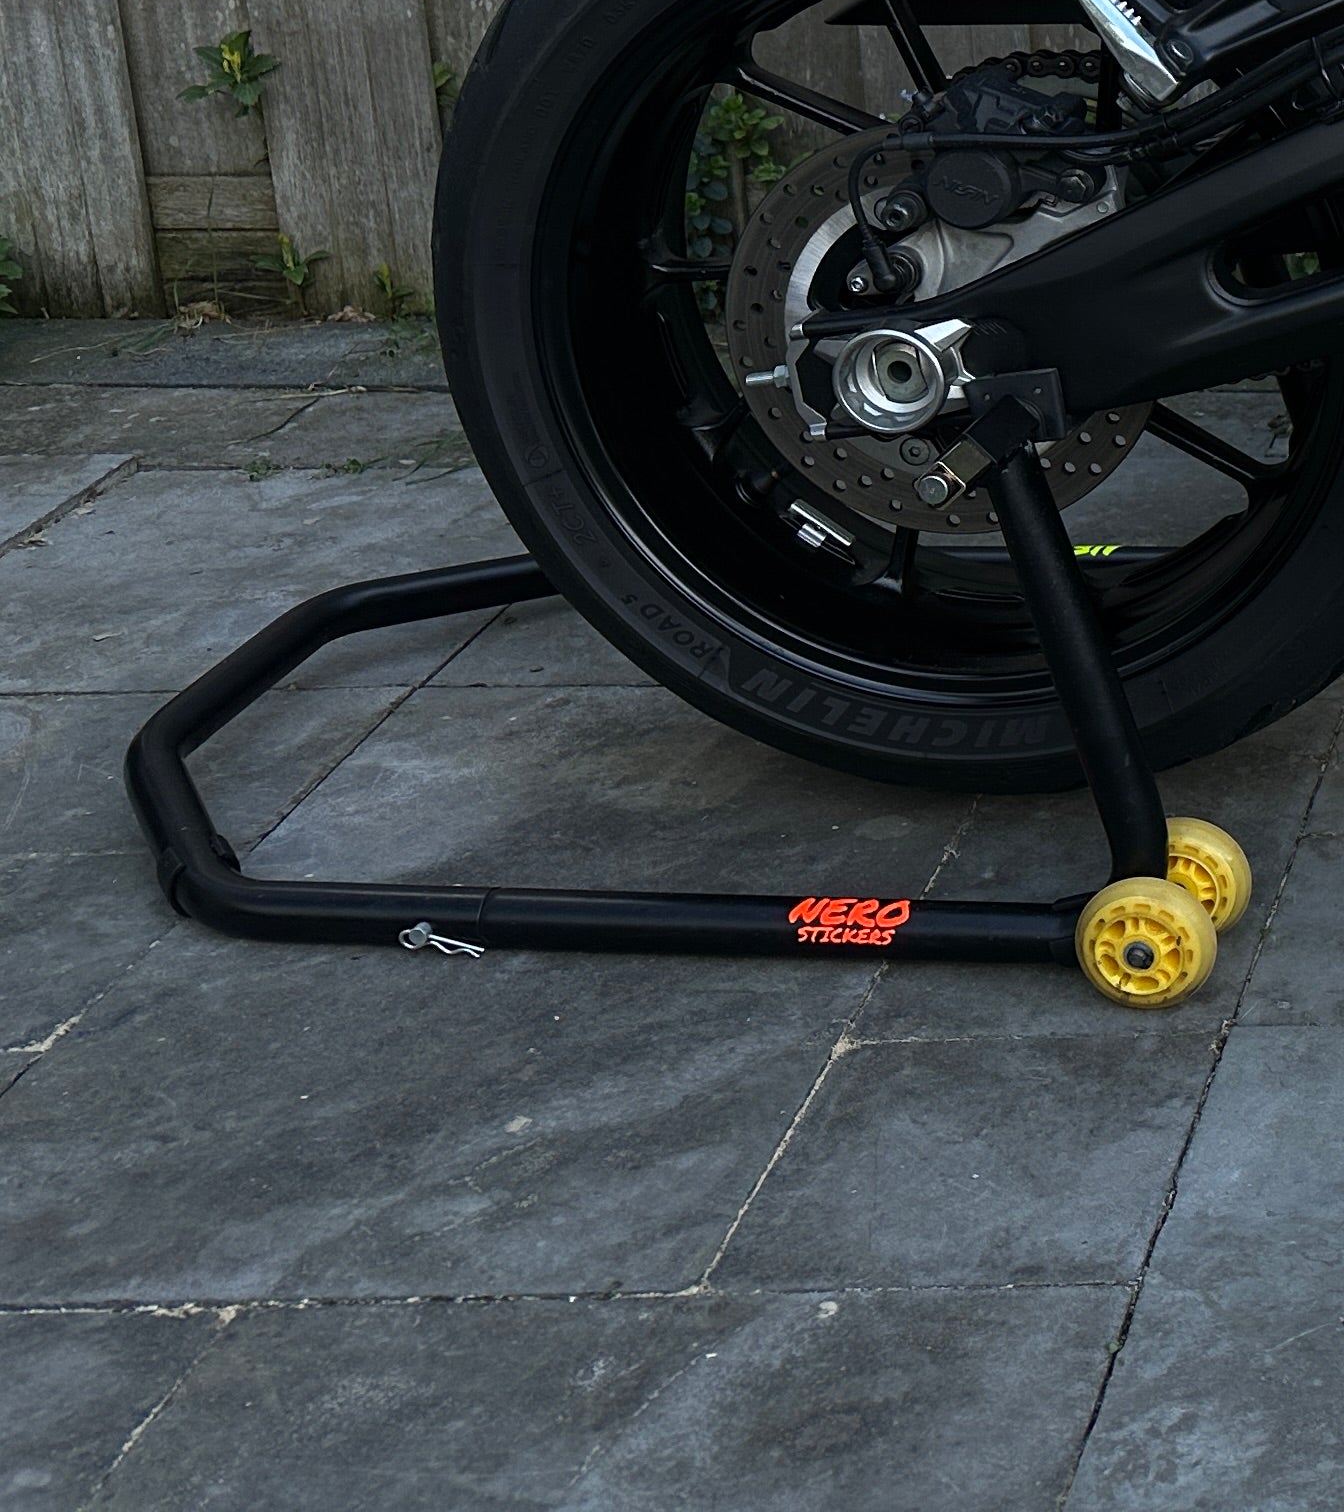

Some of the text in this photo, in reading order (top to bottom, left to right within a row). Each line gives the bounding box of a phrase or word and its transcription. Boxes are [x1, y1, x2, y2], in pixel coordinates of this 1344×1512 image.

[557, 484, 598, 547] 2CT+
[637, 598, 710, 658] ROAD
[740, 665, 1050, 750] MICHELIN
[788, 897, 911, 928] NERO
[797, 926, 896, 946] STICKERS
